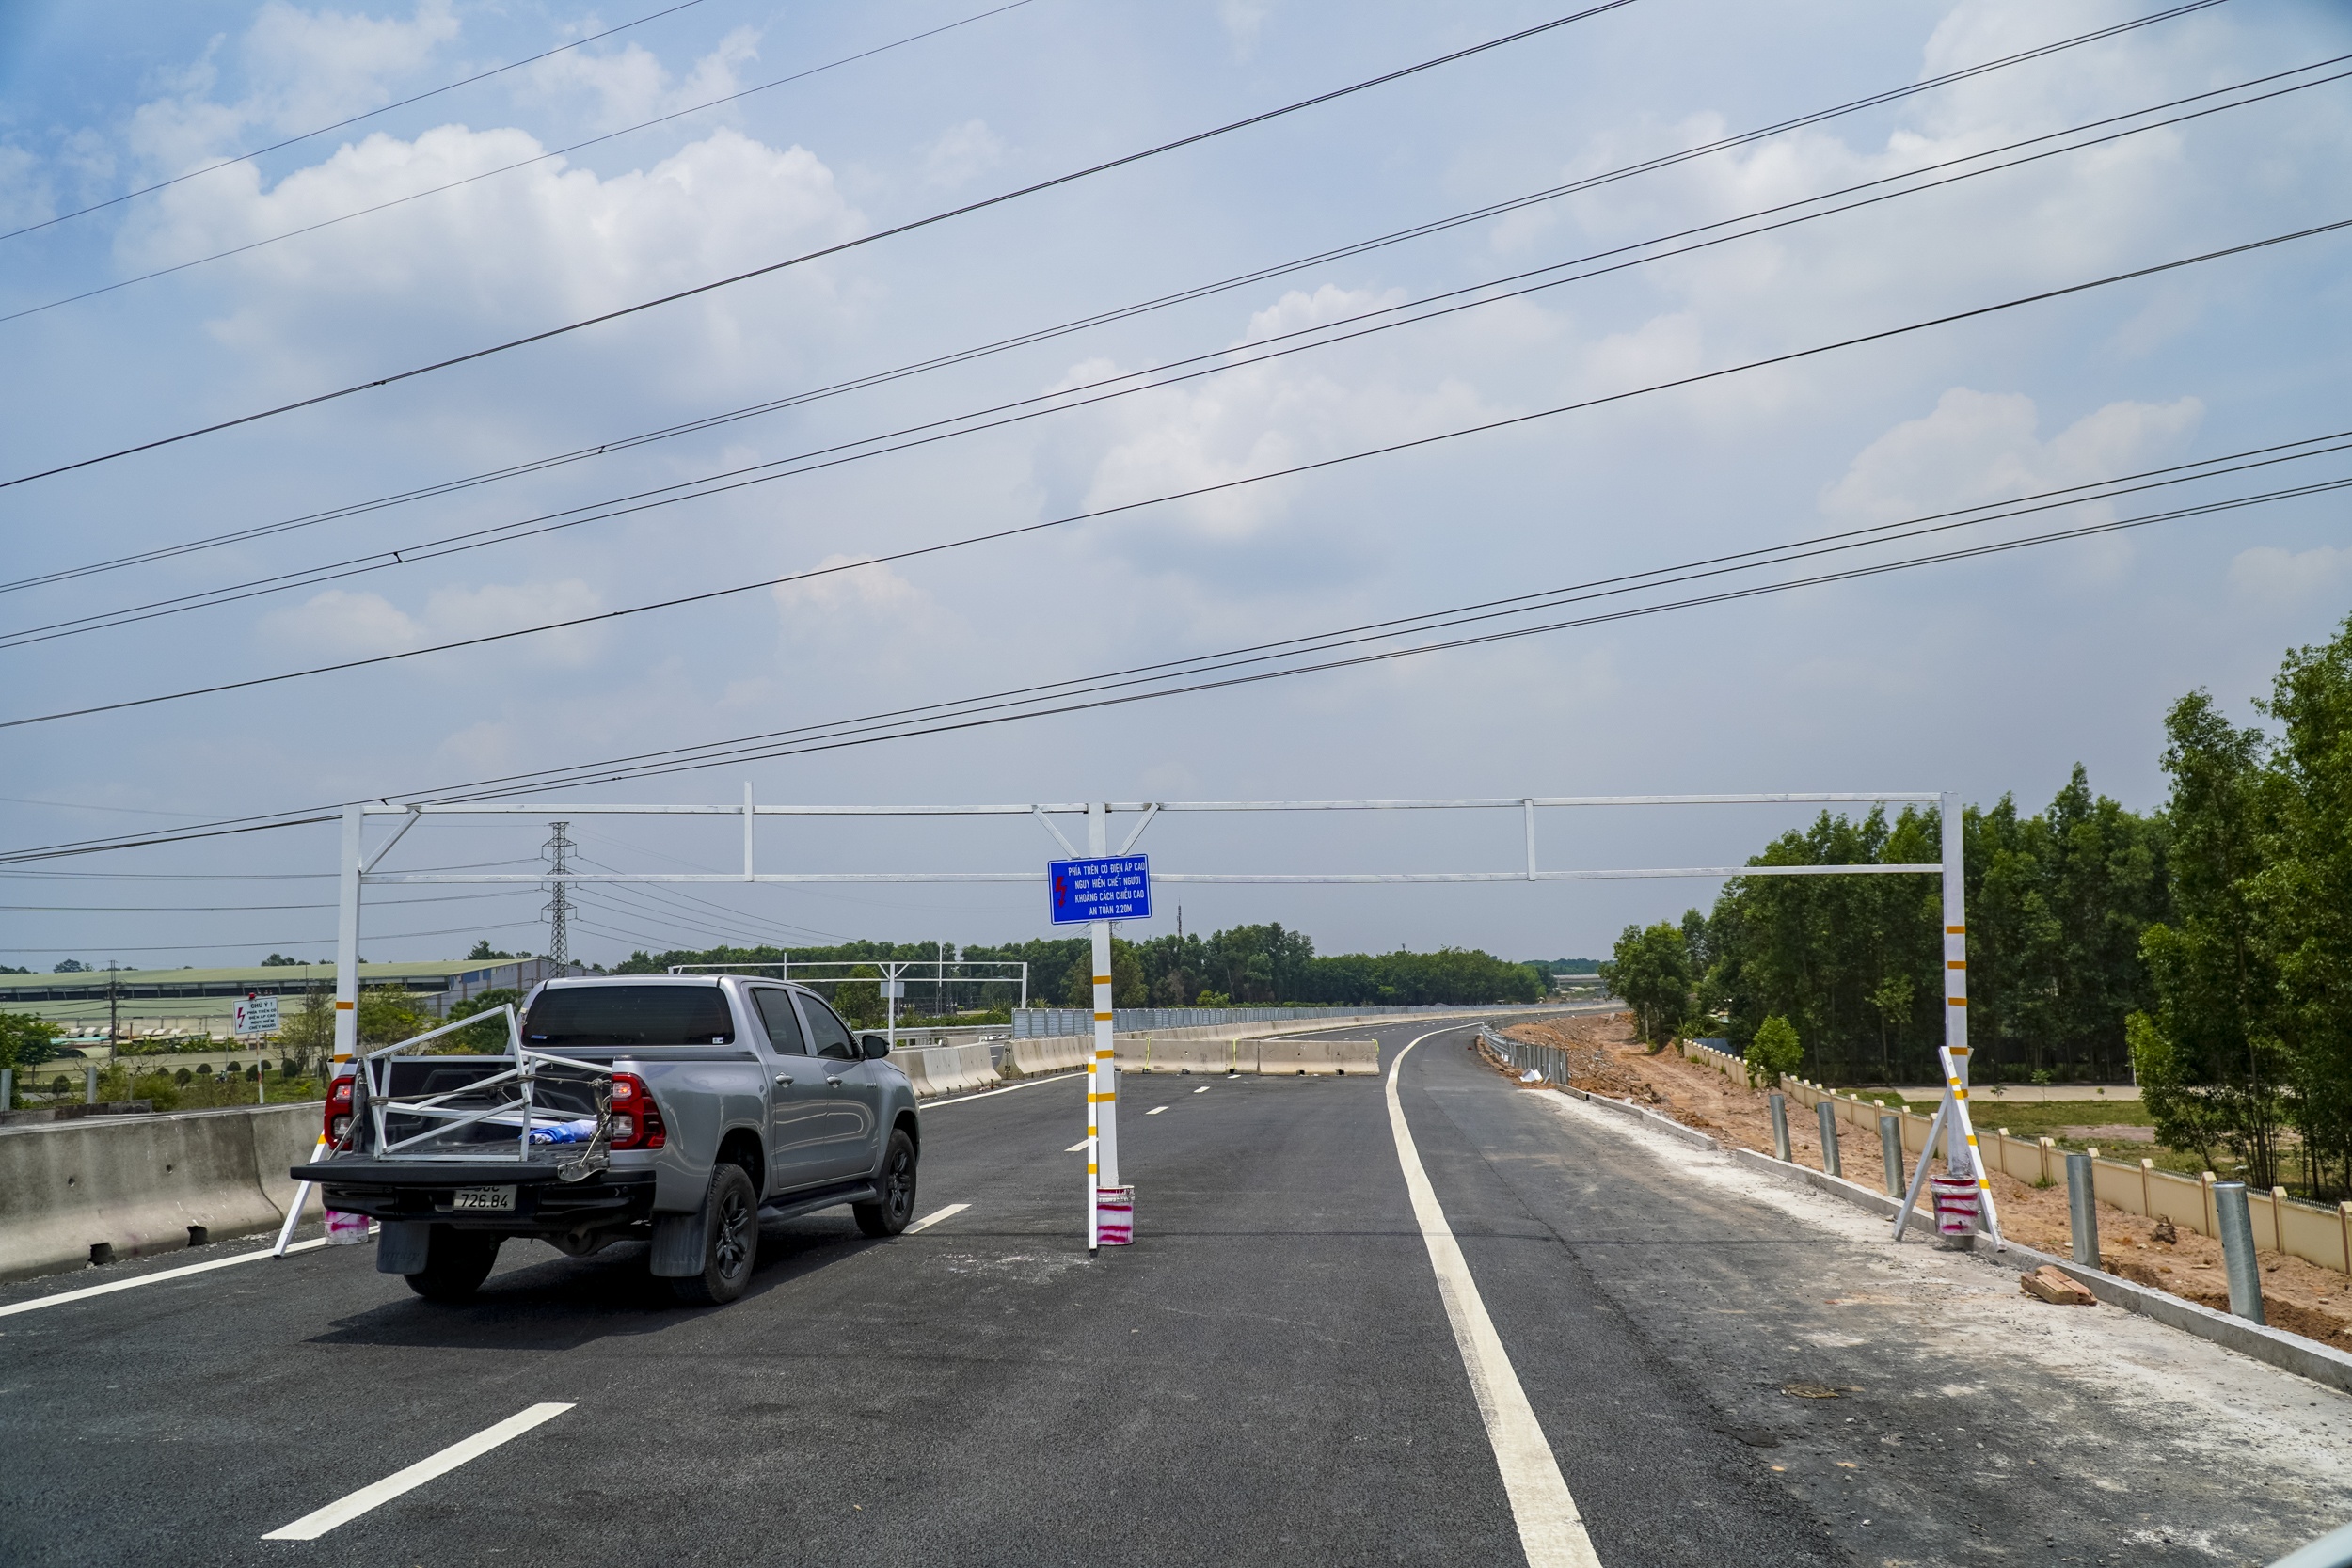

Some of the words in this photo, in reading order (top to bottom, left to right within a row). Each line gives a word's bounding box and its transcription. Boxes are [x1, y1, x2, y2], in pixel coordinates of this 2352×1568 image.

[1068, 864, 1082, 876] PHÍA
[1083, 863, 1099, 876] TRÊN
[1100, 862, 1108, 874] CÓ
[1124, 861, 1133, 872] ÁP
[1134, 862, 1146, 871] CAO
[1074, 879, 1090, 890] NGUY
[1092, 875, 1106, 889] HIỂM
[1107, 873, 1121, 887] CHẾT
[1074, 891, 1098, 903] KHOẢNG
[1099, 890, 1115, 901] CÁCH
[1115, 887, 1132, 900] CHIỀU
[1133, 889, 1145, 899] CAO
[1089, 906, 1098, 916] AN
[1098, 903, 1114, 915] TOÀN
[1115, 903, 1133, 914] 2.20M
[461, 1193, 509, 1208] 726.84
